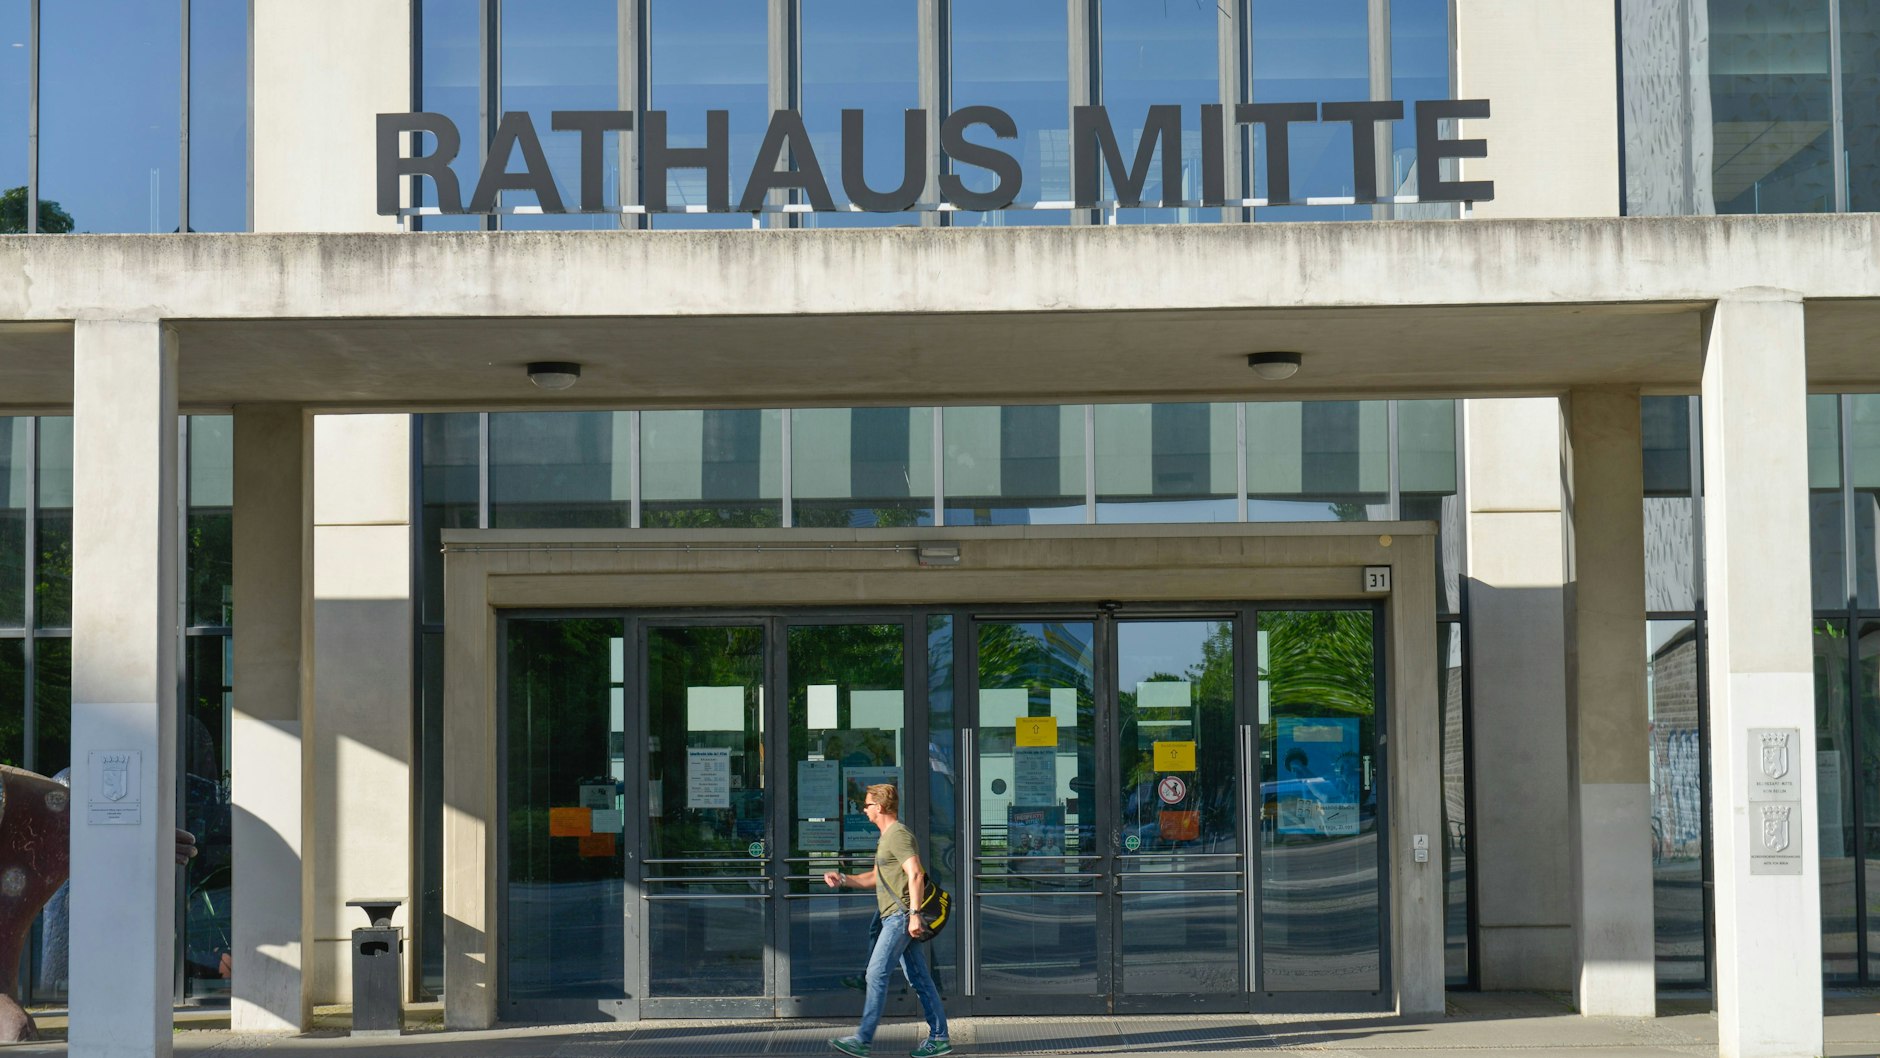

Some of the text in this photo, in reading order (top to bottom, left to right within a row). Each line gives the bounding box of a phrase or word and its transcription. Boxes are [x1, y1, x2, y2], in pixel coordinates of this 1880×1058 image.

[376, 99, 1495, 215] RATHAUS MITTE
[1370, 573, 1385, 587] 31
